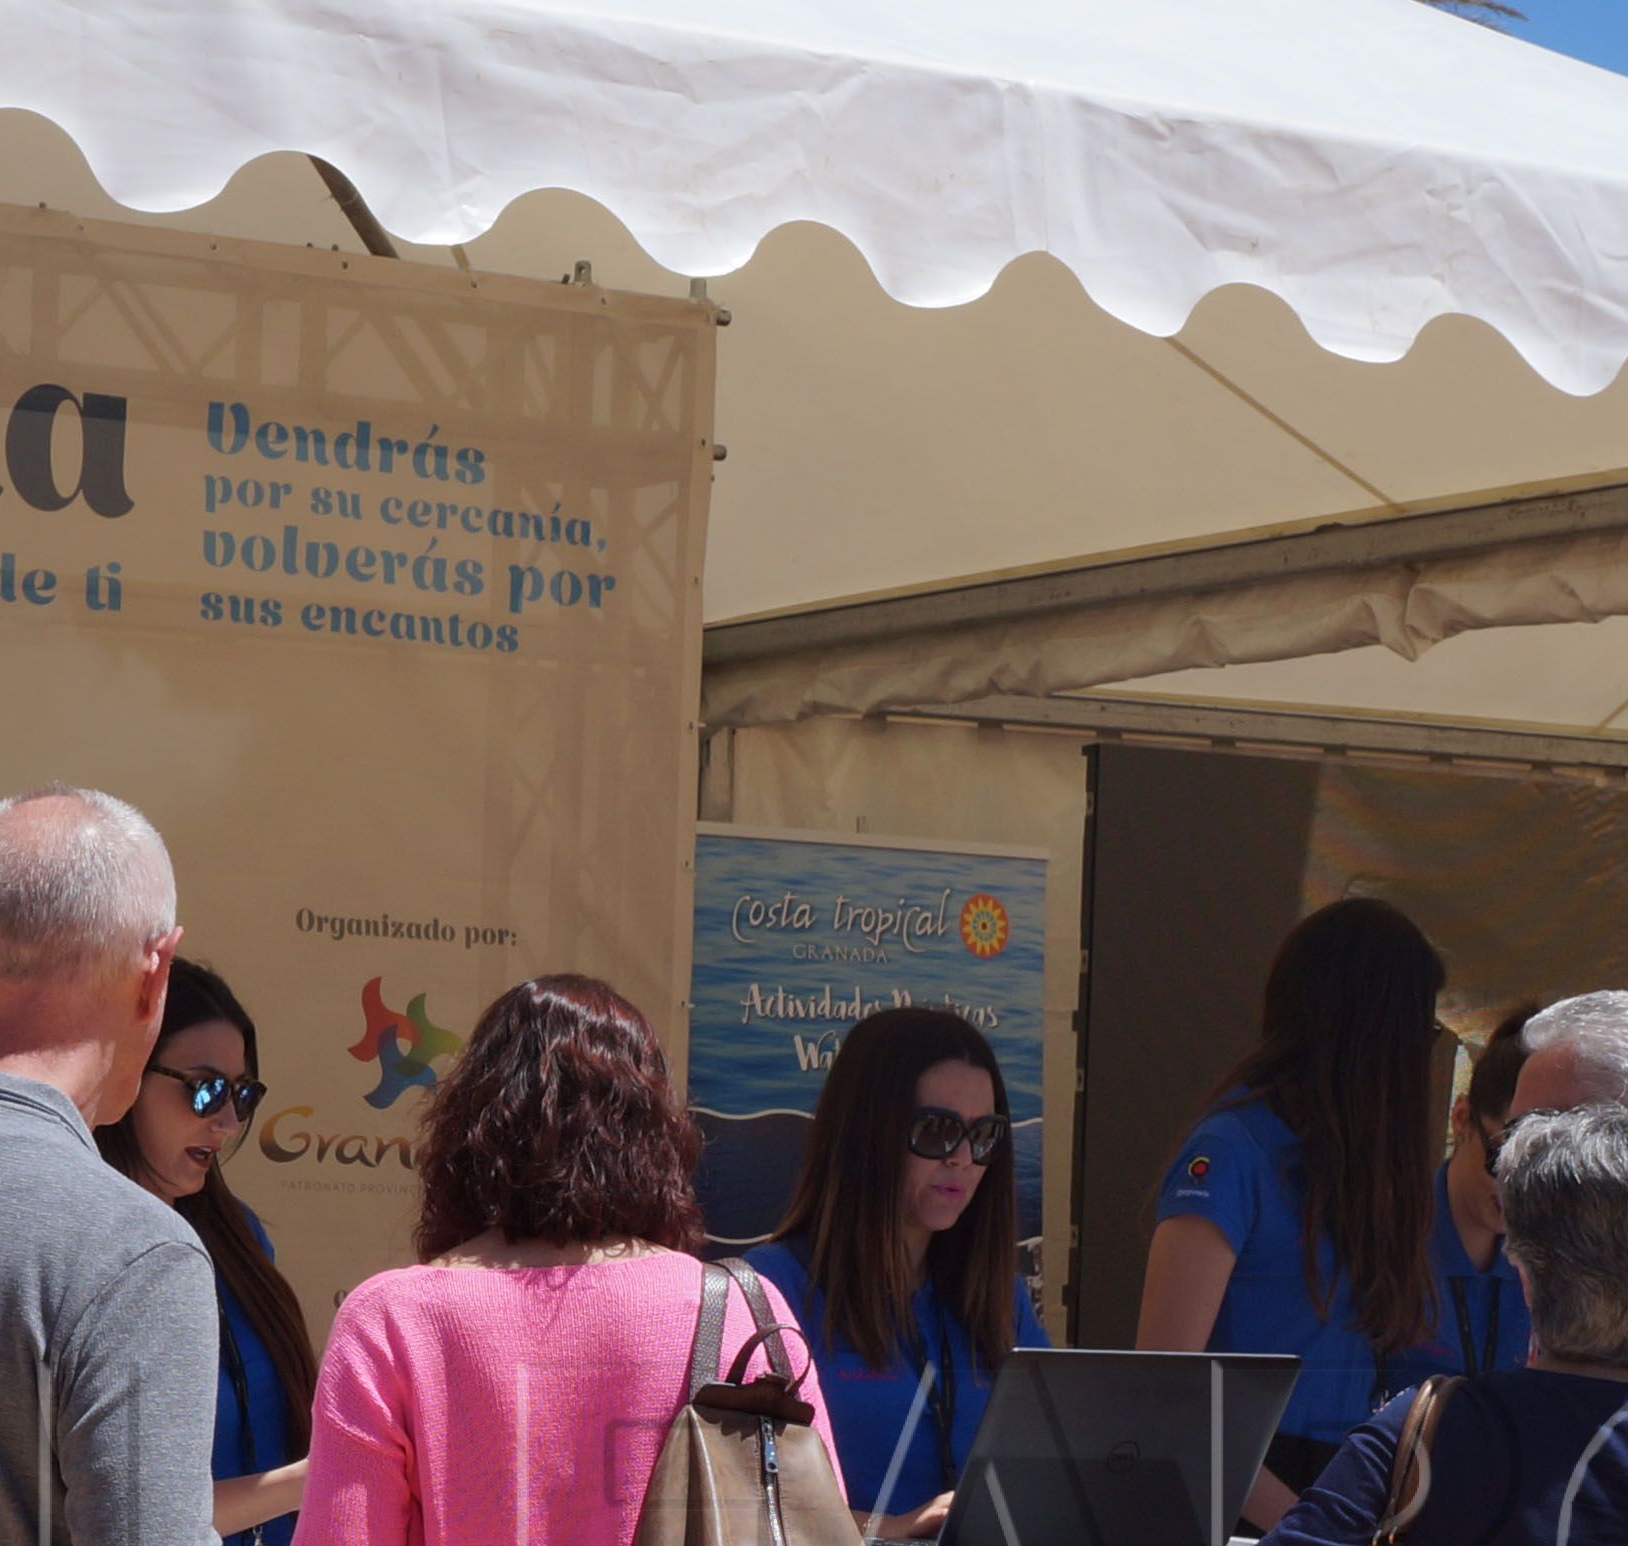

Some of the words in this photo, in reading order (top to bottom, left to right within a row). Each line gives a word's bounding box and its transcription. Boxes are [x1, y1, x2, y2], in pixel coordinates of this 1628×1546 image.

[206, 402, 487, 485] Vendrás
[204, 474, 292, 512] por
[310, 487, 363, 522] su
[380, 502, 608, 552] cercanía,
[85, 561, 123, 611] ti
[203, 525, 485, 597] volverás
[508, 564, 617, 614] por
[200, 591, 282, 630] sus
[301, 602, 520, 653] encantos
[296, 908, 455, 943] Organizado
[465, 926, 518, 949] por:
[793, 943, 888, 963] GRANADA
